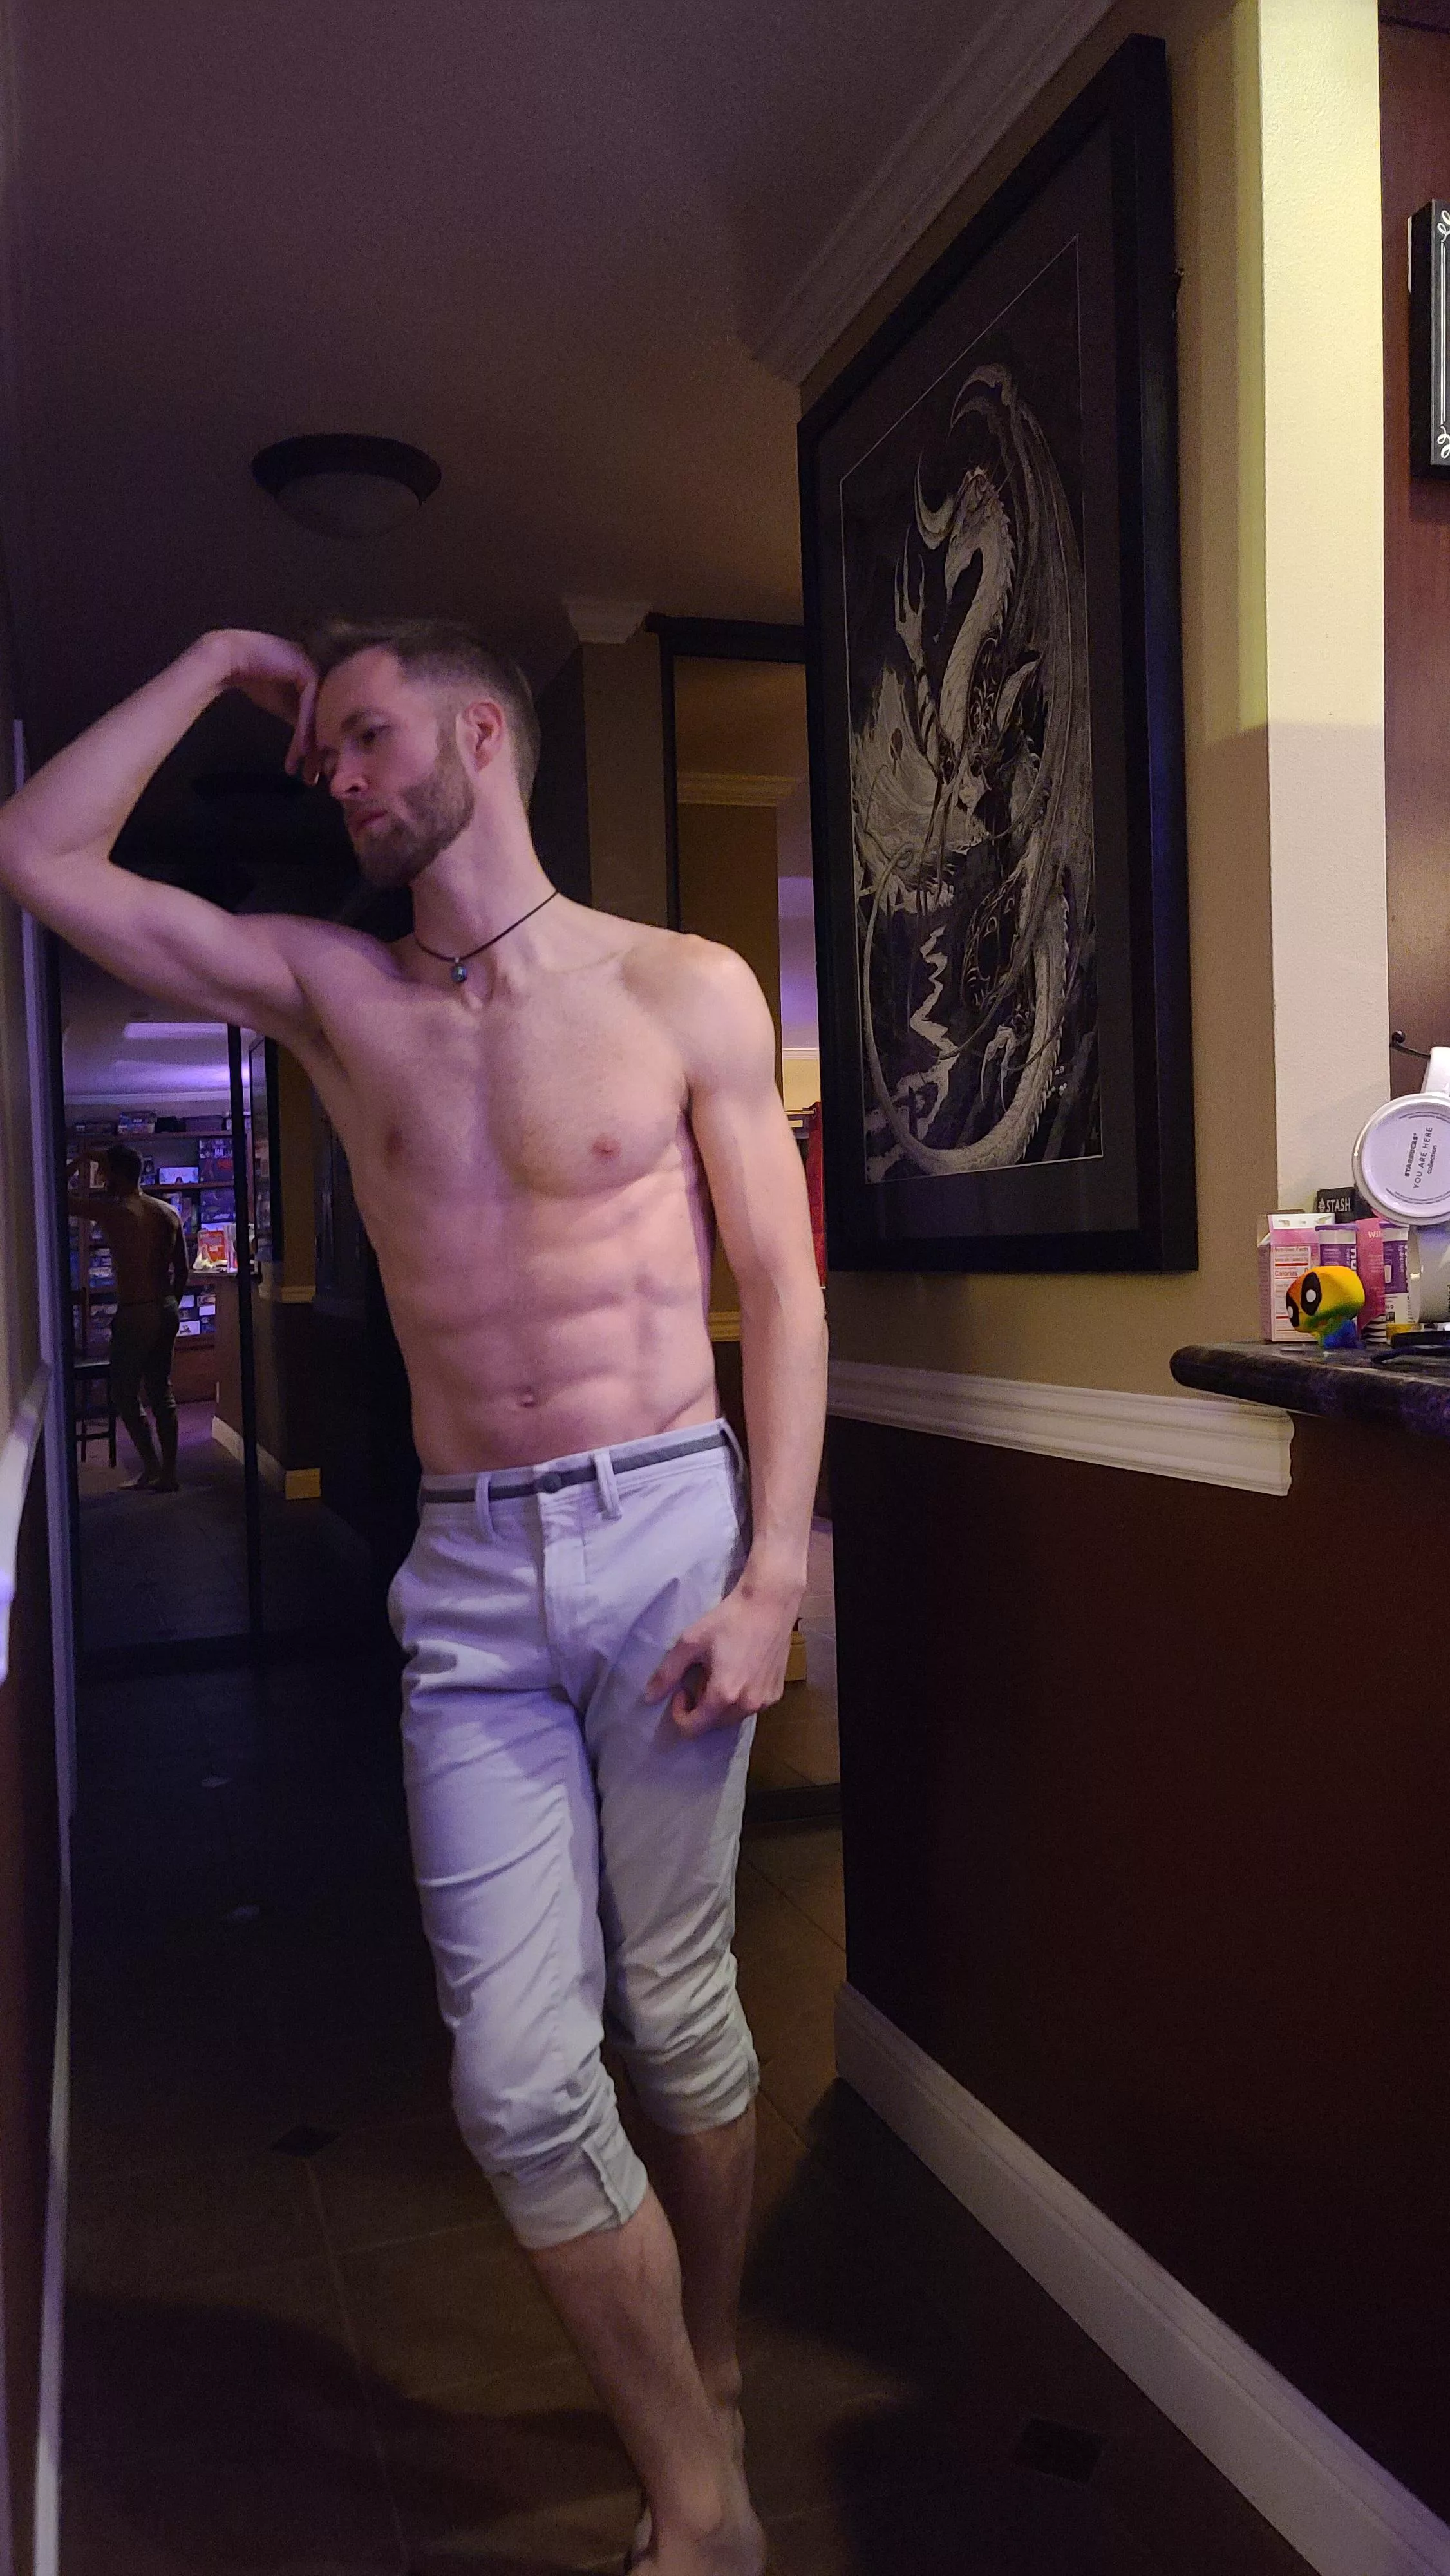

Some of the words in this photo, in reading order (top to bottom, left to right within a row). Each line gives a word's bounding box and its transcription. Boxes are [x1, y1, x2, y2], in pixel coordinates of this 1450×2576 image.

[1422, 1127, 1433, 1148] HERE
[1418, 1152, 1427, 1168] ARE
[1427, 1145, 1437, 1175] collection
[1413, 1171, 1422, 1189] YOU
[1326, 1197, 1351, 1212] STASH
